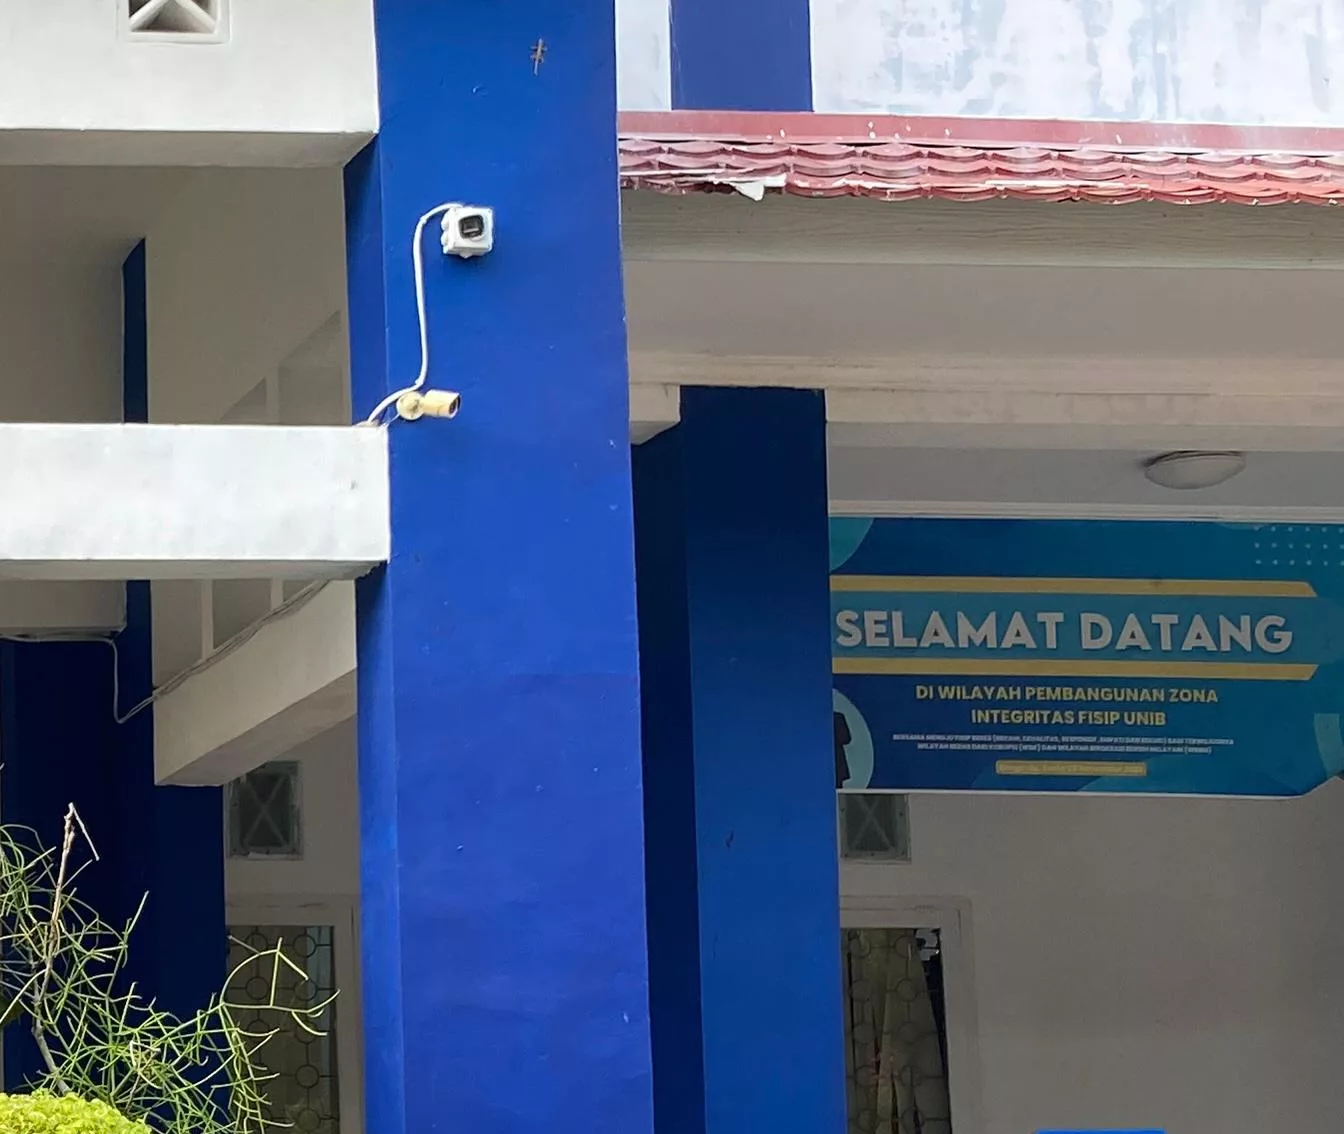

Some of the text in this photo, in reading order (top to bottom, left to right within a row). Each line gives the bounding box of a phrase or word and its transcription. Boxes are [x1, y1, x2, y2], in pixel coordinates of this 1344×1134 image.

[836, 610, 1292, 654] SELAMAT DATANG
[916, 685, 1218, 703] DI WILAYAH PEMBANGUNAN ZONA
[971, 709, 1166, 726] INTEGRITAS FISIP UNIB
